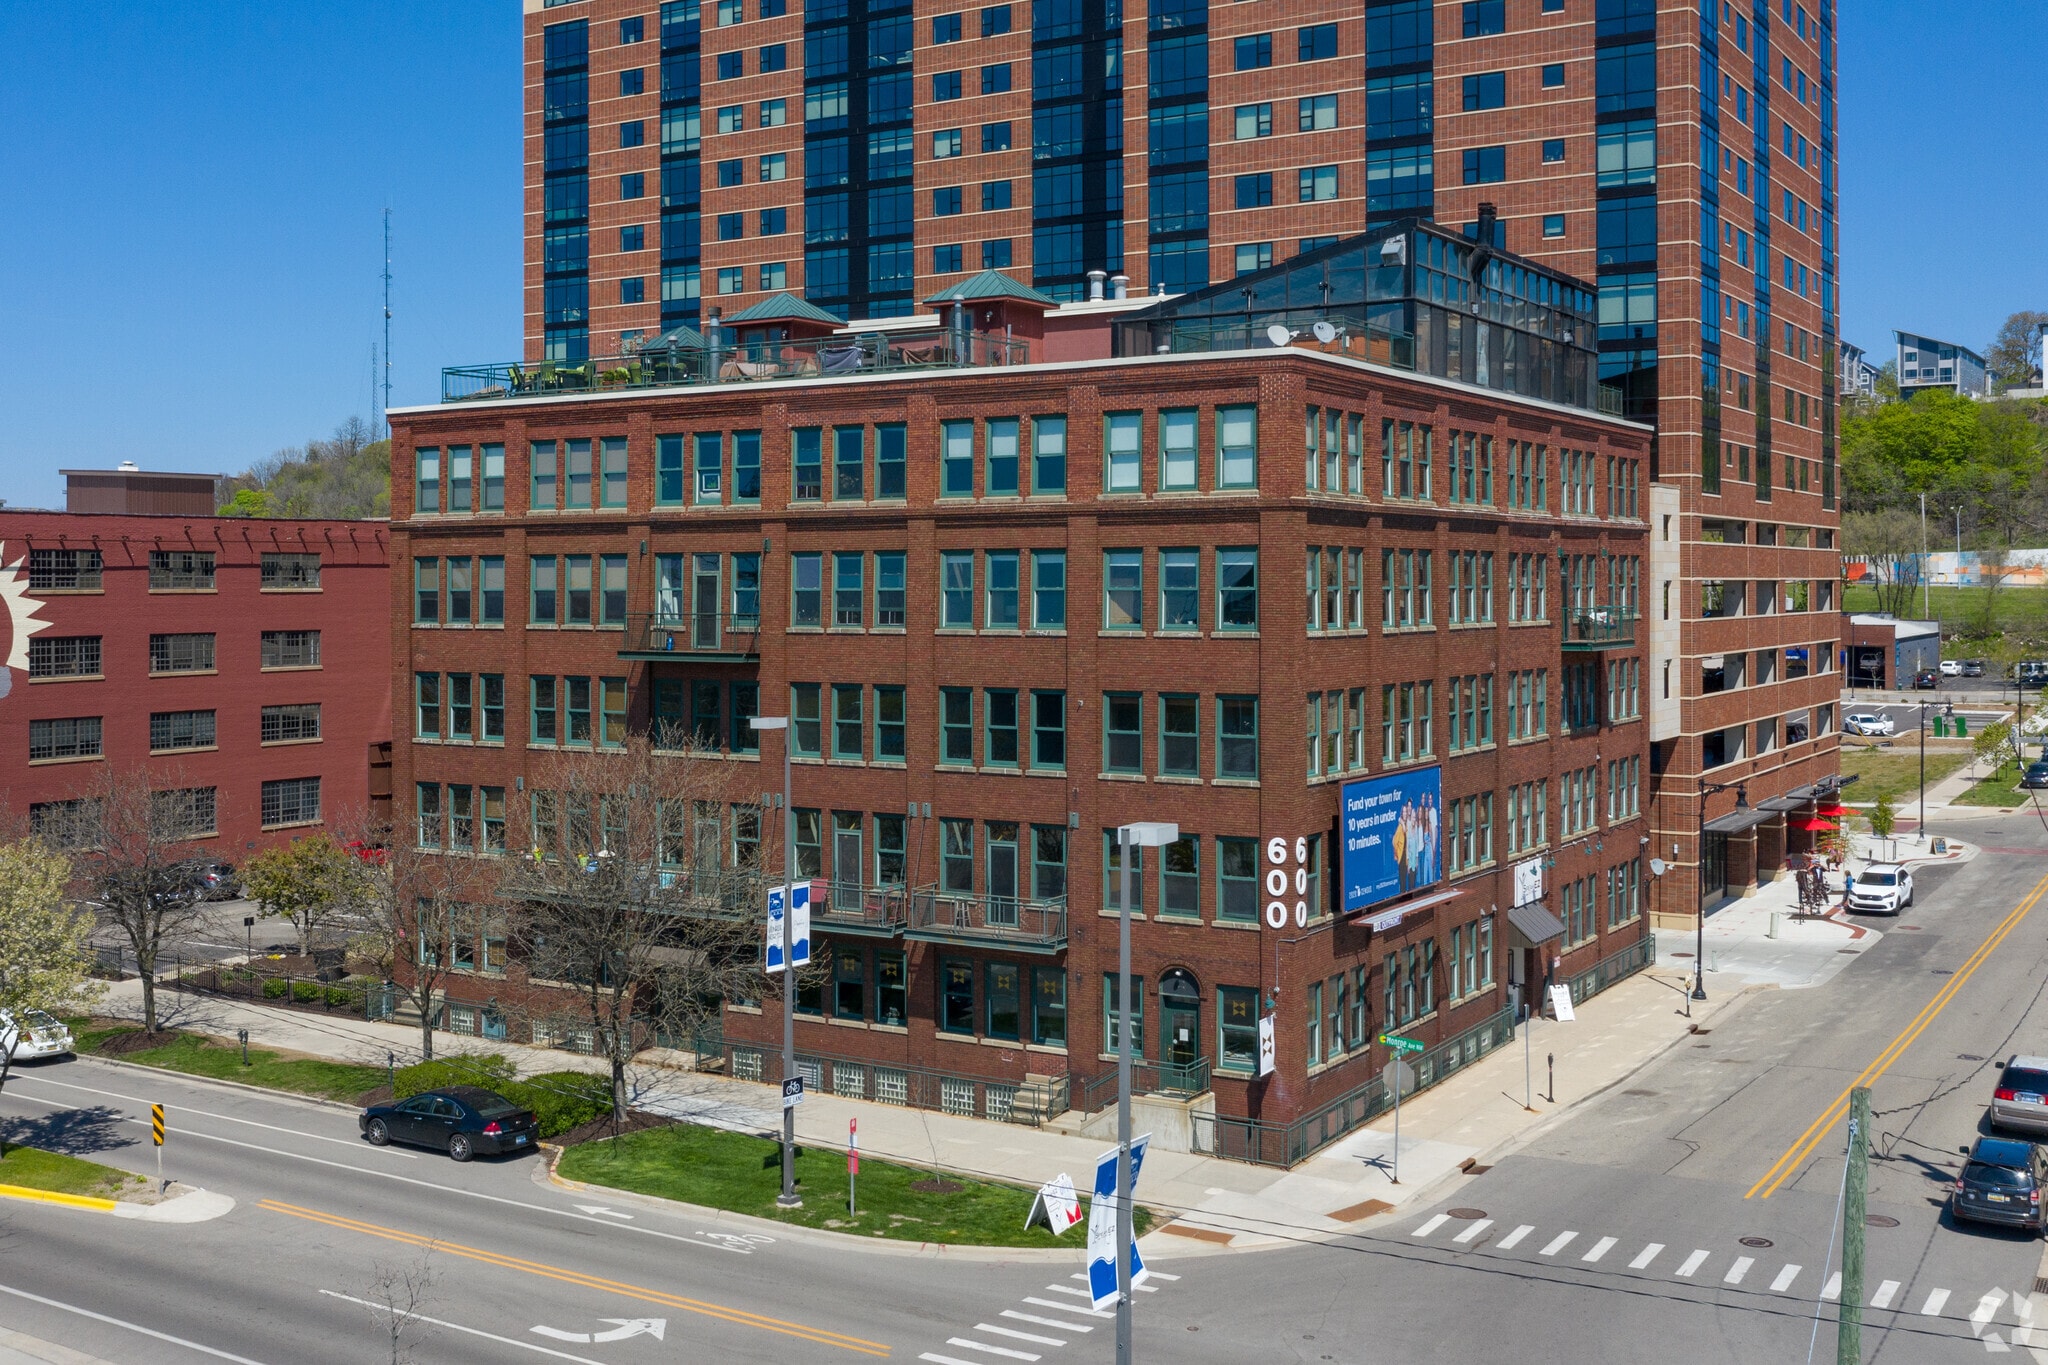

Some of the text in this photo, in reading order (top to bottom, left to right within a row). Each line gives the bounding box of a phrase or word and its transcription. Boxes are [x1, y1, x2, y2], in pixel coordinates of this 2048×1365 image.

[1348, 789, 1402, 811] Fund your town for
[1348, 809, 1397, 832] 10 years in under
[1348, 834, 1381, 851] 10 minutes.
[1266, 837, 1288, 929] 600
[1295, 836, 1307, 928] 600
[1387, 1037, 1407, 1048] Monroe
